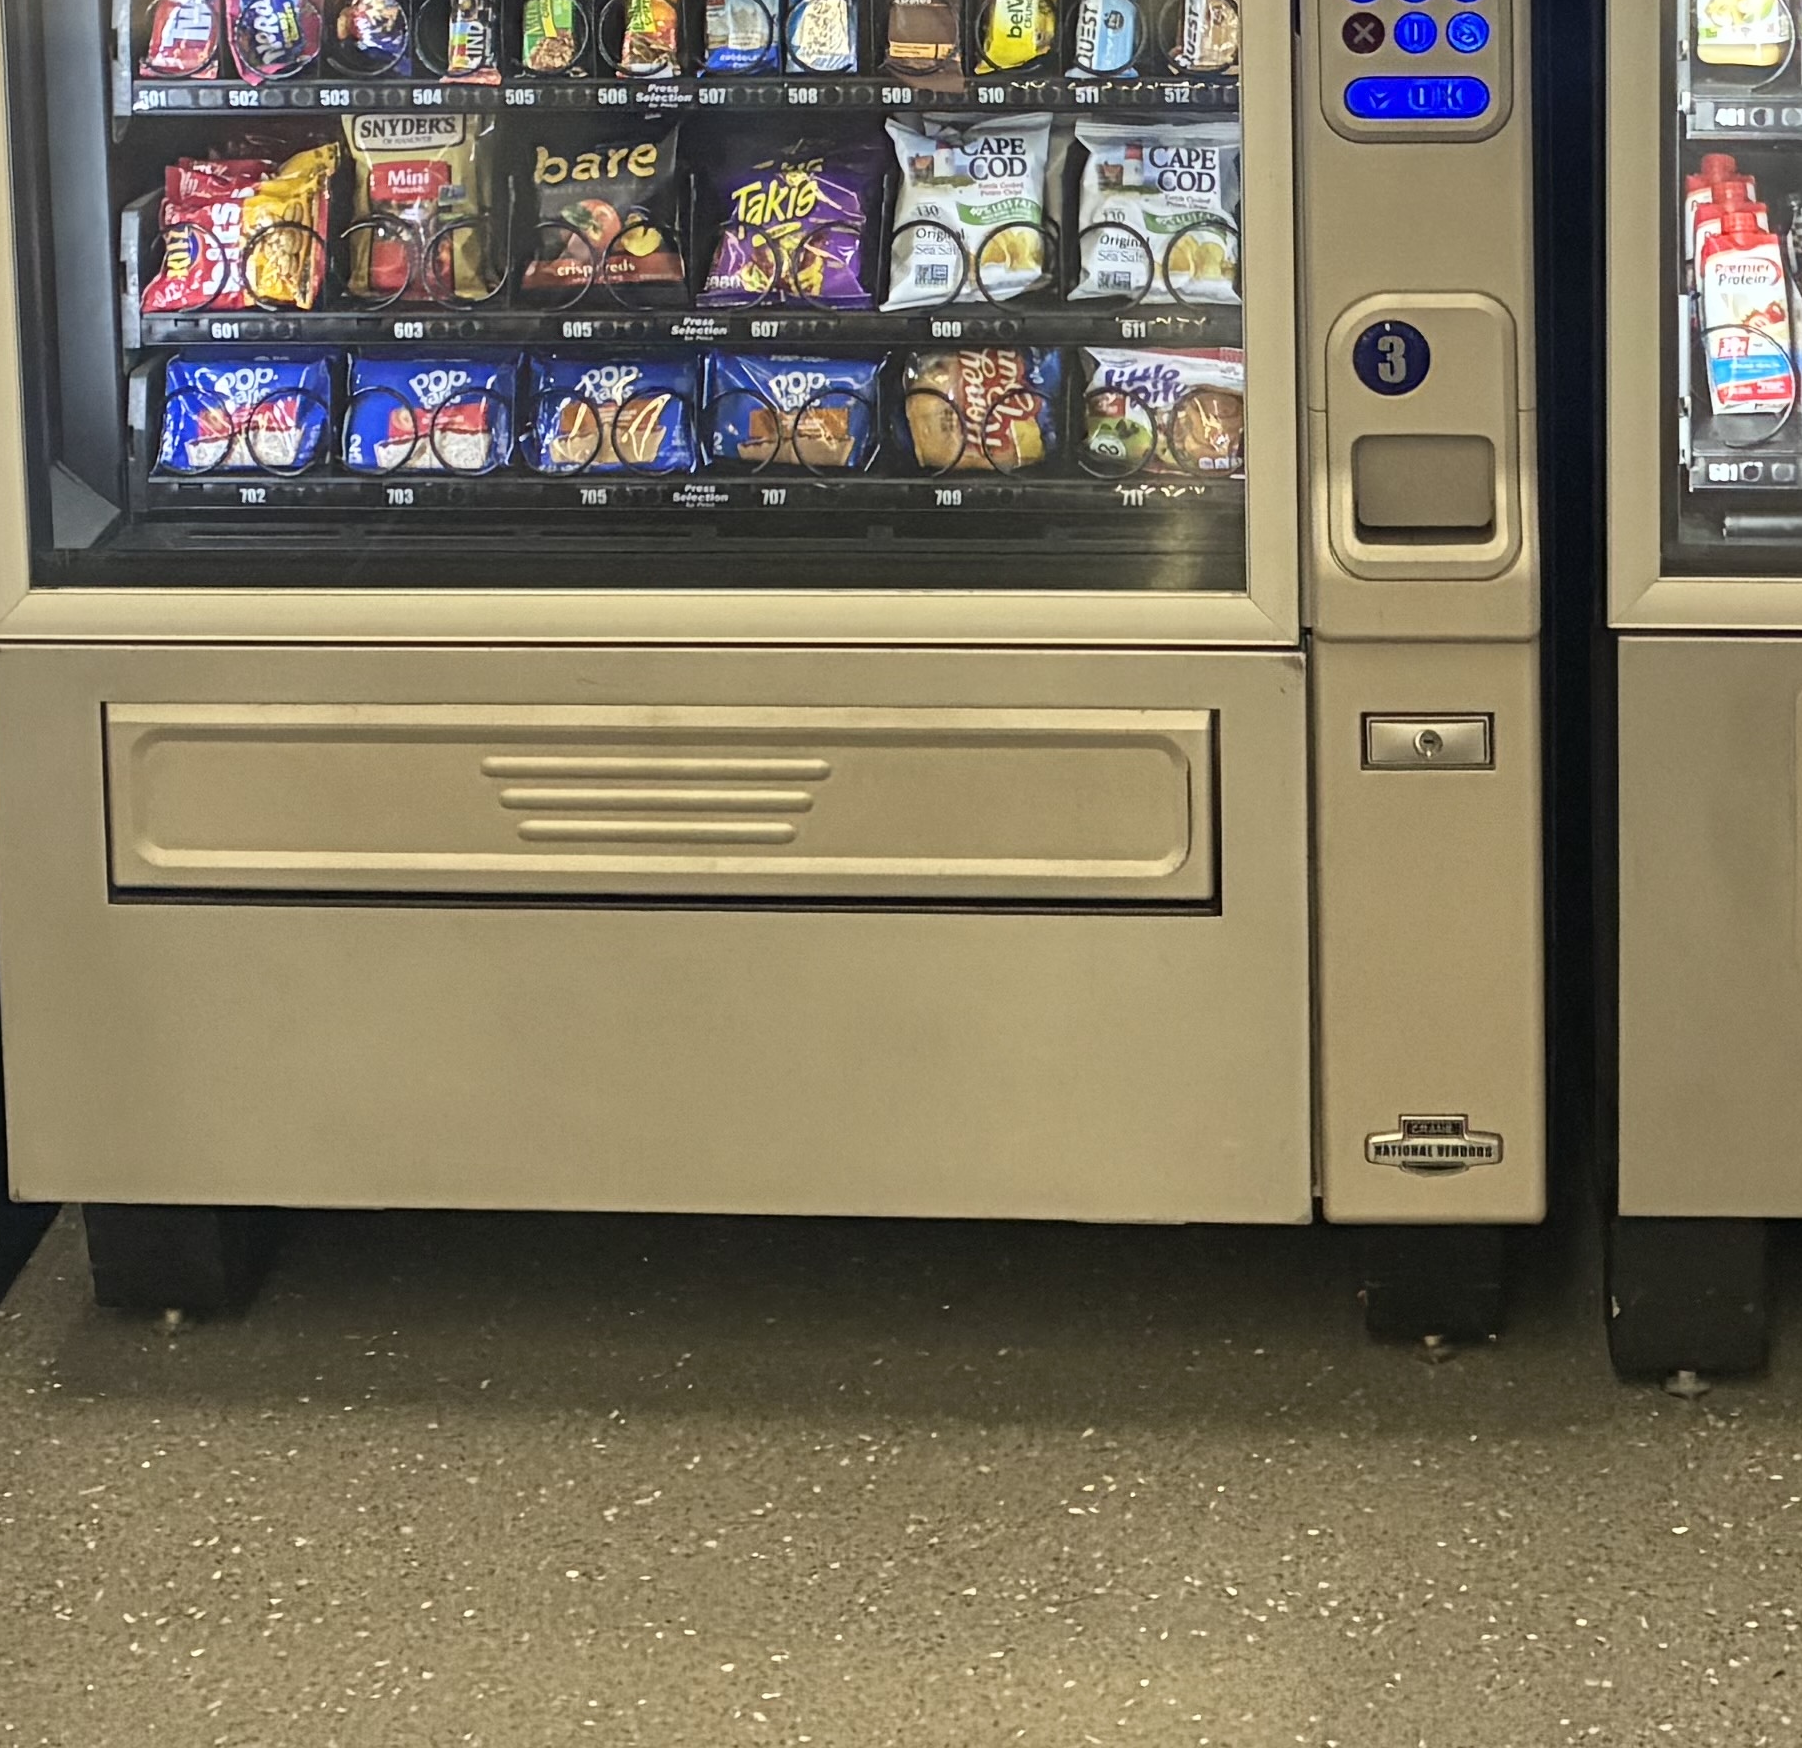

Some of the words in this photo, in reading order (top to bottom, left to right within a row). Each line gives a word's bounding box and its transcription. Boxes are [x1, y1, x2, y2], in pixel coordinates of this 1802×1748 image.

[1076, 3, 1098, 70] QUEST
[413, 88, 442, 106] 504
[882, 87, 912, 105] 509
[360, 115, 457, 140] SNYDER'S
[959, 137, 1025, 158] CAPE
[535, 144, 658, 183] bare
[1149, 146, 1217, 170] CAPE
[387, 169, 430, 187] Mini
[968, 156, 1028, 181] COD
[1158, 169, 1217, 193] COD
[732, 181, 816, 224] Takis
[1715, 262, 1769, 277] Premier
[1718, 274, 1767, 285] Protein
[212, 322, 239, 339] 601
[751, 320, 778, 338] 607
[1378, 335, 1406, 383] 3
[387, 488, 413, 505] 703
[762, 488, 785, 505] 707
